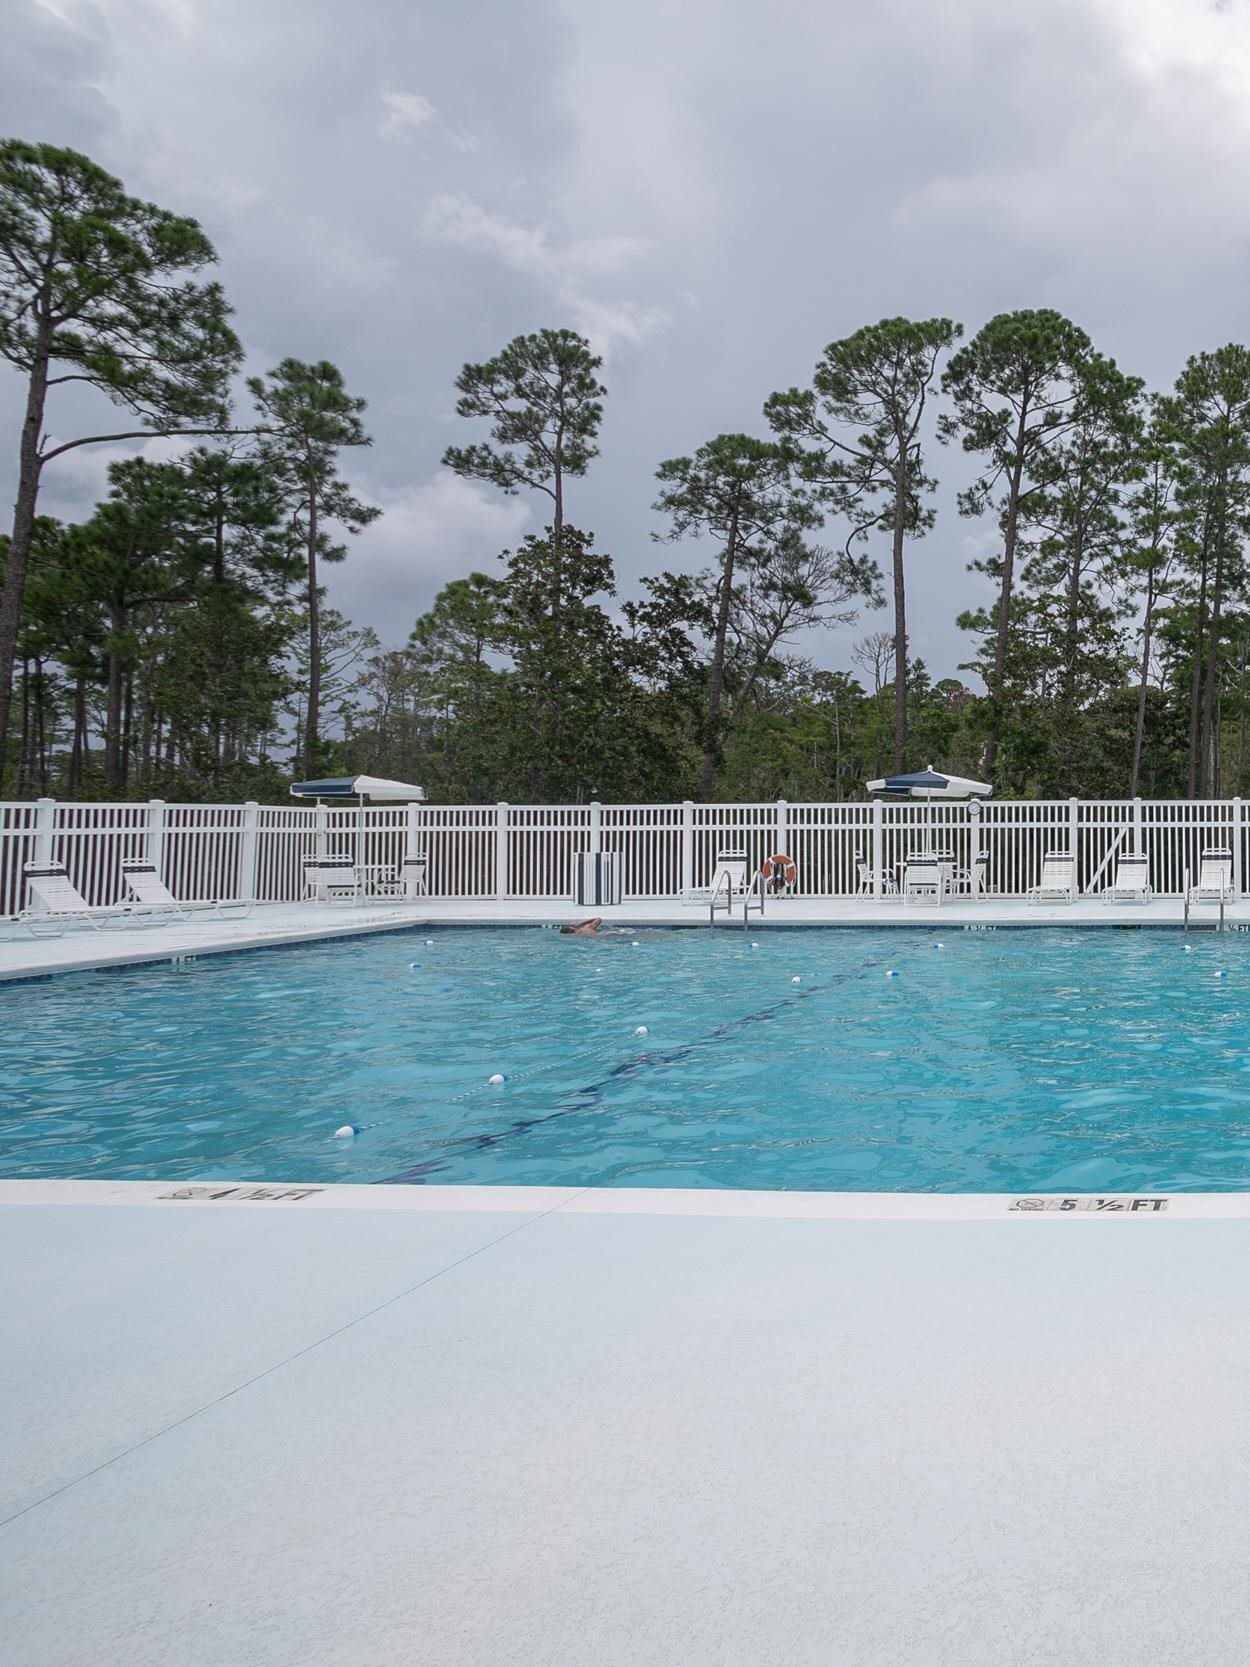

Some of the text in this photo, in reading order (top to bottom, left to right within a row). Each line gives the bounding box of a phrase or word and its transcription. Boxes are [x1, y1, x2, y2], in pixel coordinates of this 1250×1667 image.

[1238, 923, 1248, 932] FT
[271, 1186, 327, 1200] FT
[1059, 1199, 1078, 1211] 5
[1131, 1199, 1168, 1211] FT
